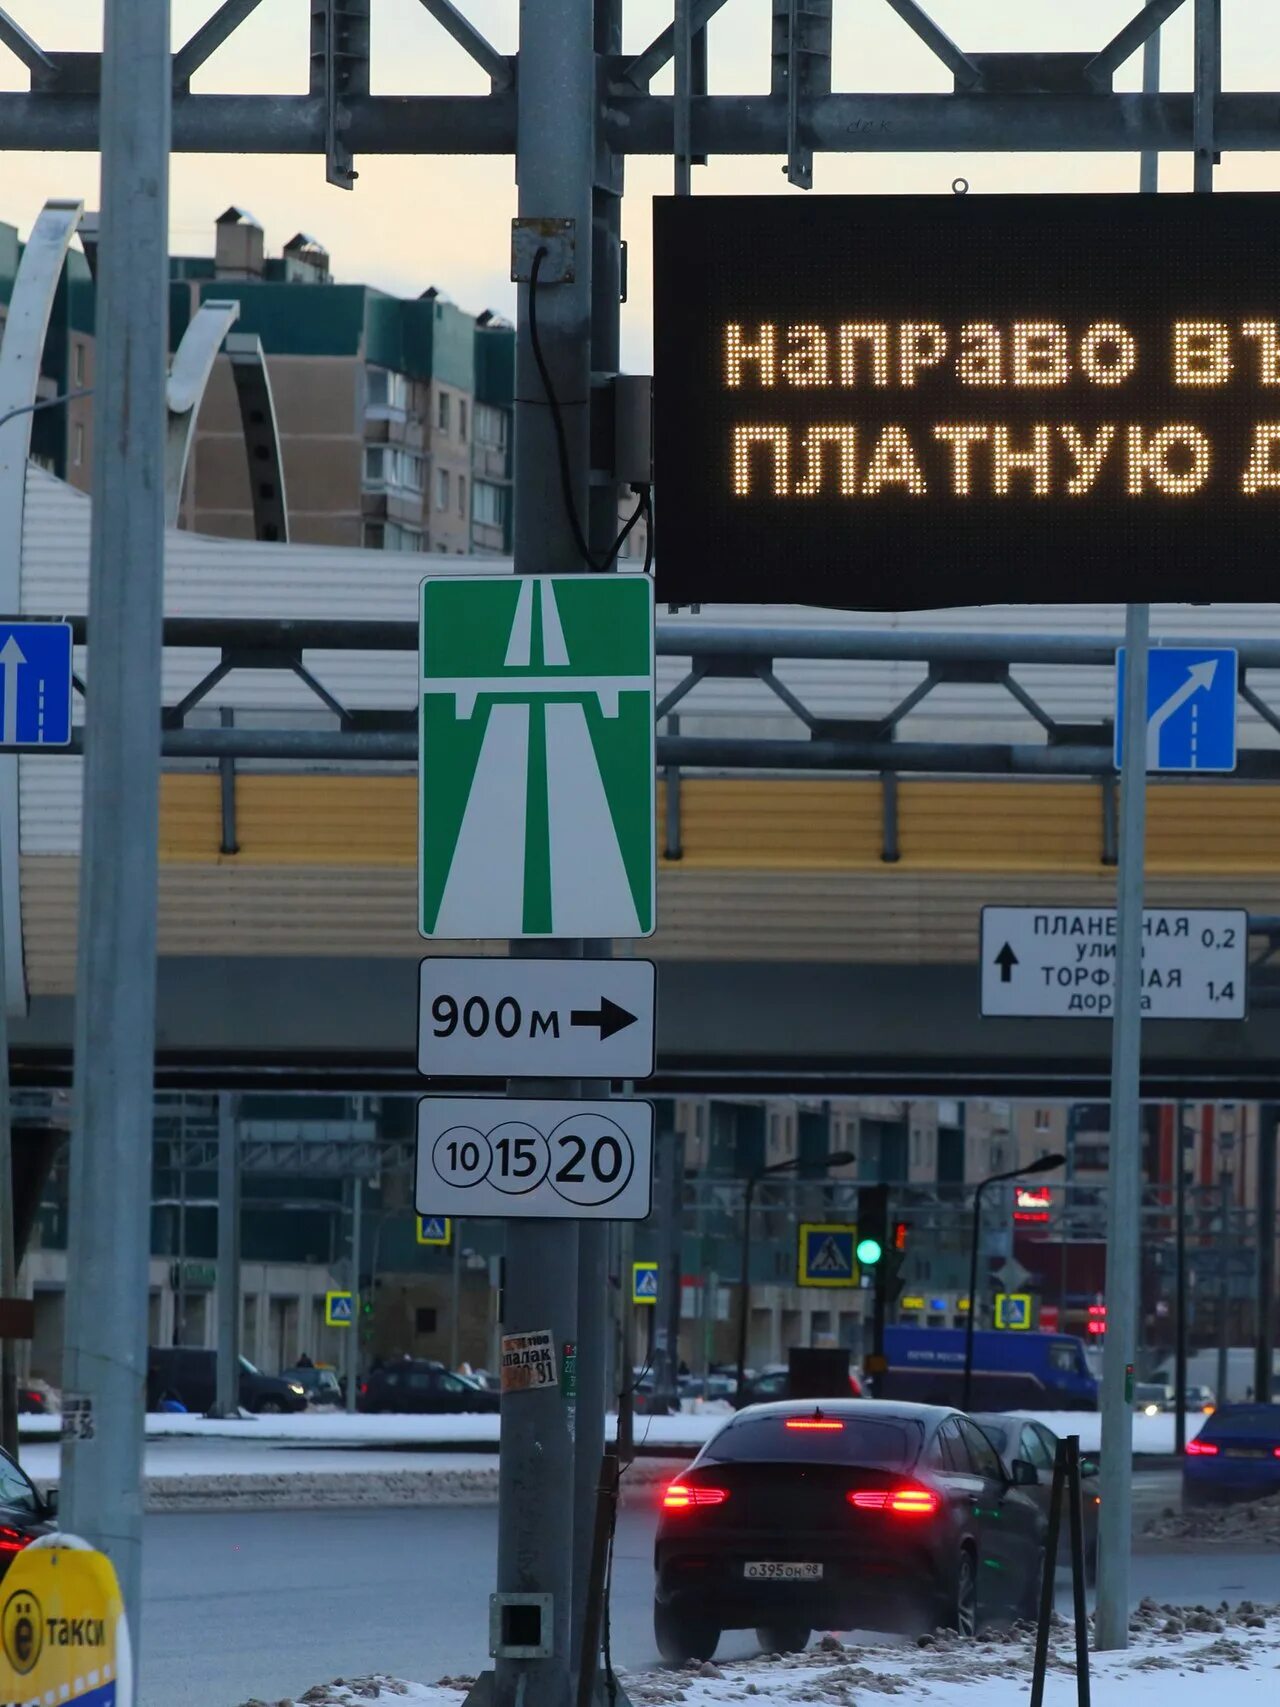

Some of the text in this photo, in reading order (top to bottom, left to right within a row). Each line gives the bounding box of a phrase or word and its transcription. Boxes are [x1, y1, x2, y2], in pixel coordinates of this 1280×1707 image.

[733, 425, 1211, 496] ПЛАТНУЮ
[1033, 915, 1236, 950] ПЛАНЕНАЯ 0,2
[1076, 942, 1146, 962] ули
[1041, 966, 1235, 1001] ТОРФАЯ 1,4
[1068, 993, 1152, 1014] дора
[446, 1134, 623, 1184] 10 15 20
